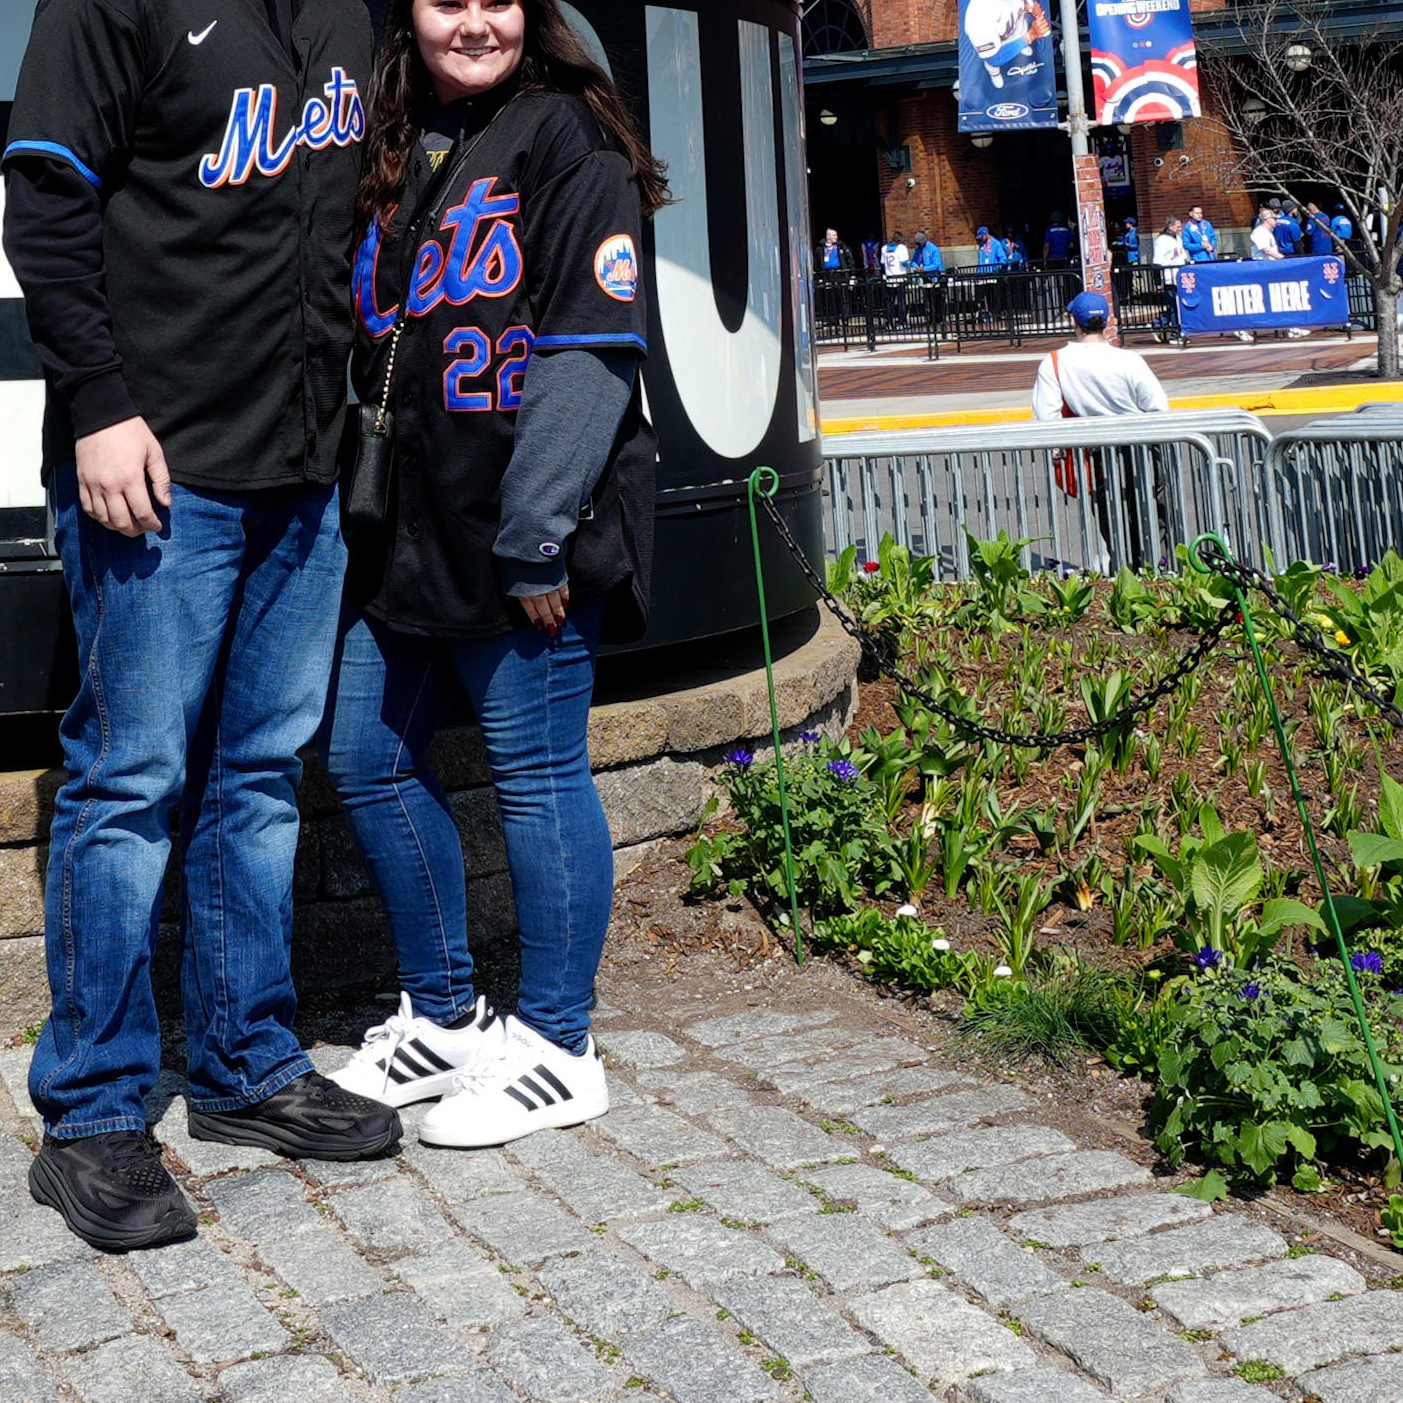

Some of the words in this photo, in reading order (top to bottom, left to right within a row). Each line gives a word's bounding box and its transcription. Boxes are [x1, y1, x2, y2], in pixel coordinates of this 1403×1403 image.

[1096, 2, 1136, 17] OPENING
[198, 66, 365, 189] Mets
[990, 105, 1025, 119] Ford
[1211, 284, 1265, 316] ENTER
[1268, 281, 1312, 312] HERE
[443, 325, 537, 412] 22
